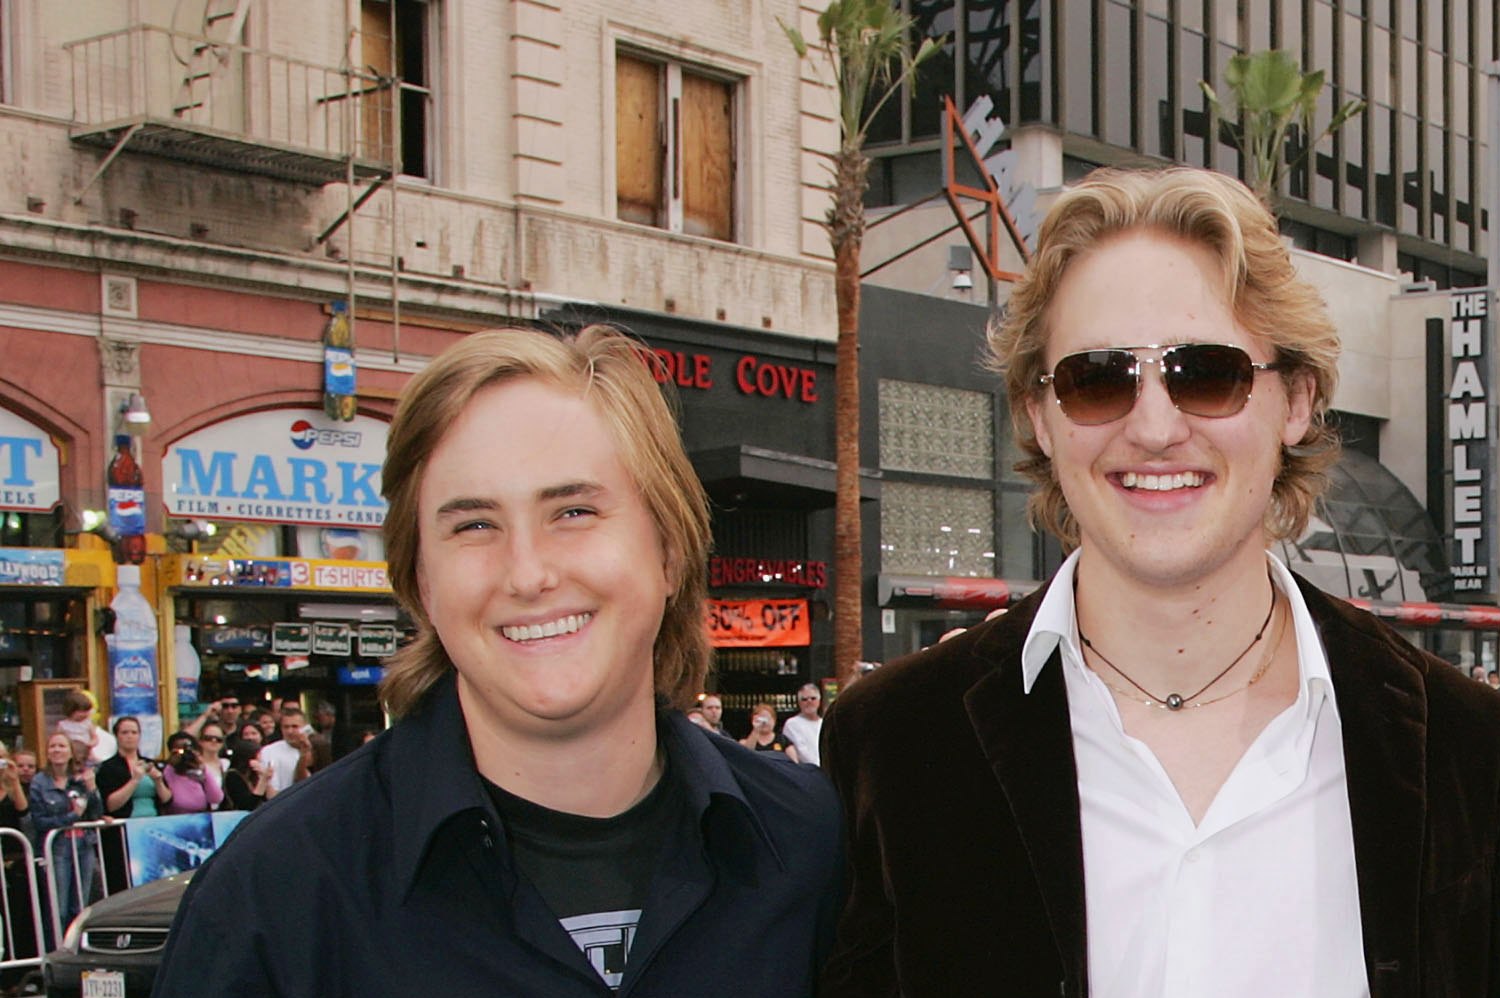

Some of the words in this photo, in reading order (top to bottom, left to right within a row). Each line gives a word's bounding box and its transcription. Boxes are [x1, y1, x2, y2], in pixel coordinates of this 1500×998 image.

[1449, 294, 1487, 317] THE
[736, 356, 819, 403] COVE
[304, 428, 362, 448] PEPSI
[1449, 320, 1486, 564] HAMLET
[177, 499, 219, 514] FILM
[238, 505, 332, 521] CIGARETTES
[294, 563, 309, 584] 3
[314, 566, 385, 586] T-SHIRTS
[1454, 578, 1482, 591] REAR
[760, 603, 801, 632] OFF
